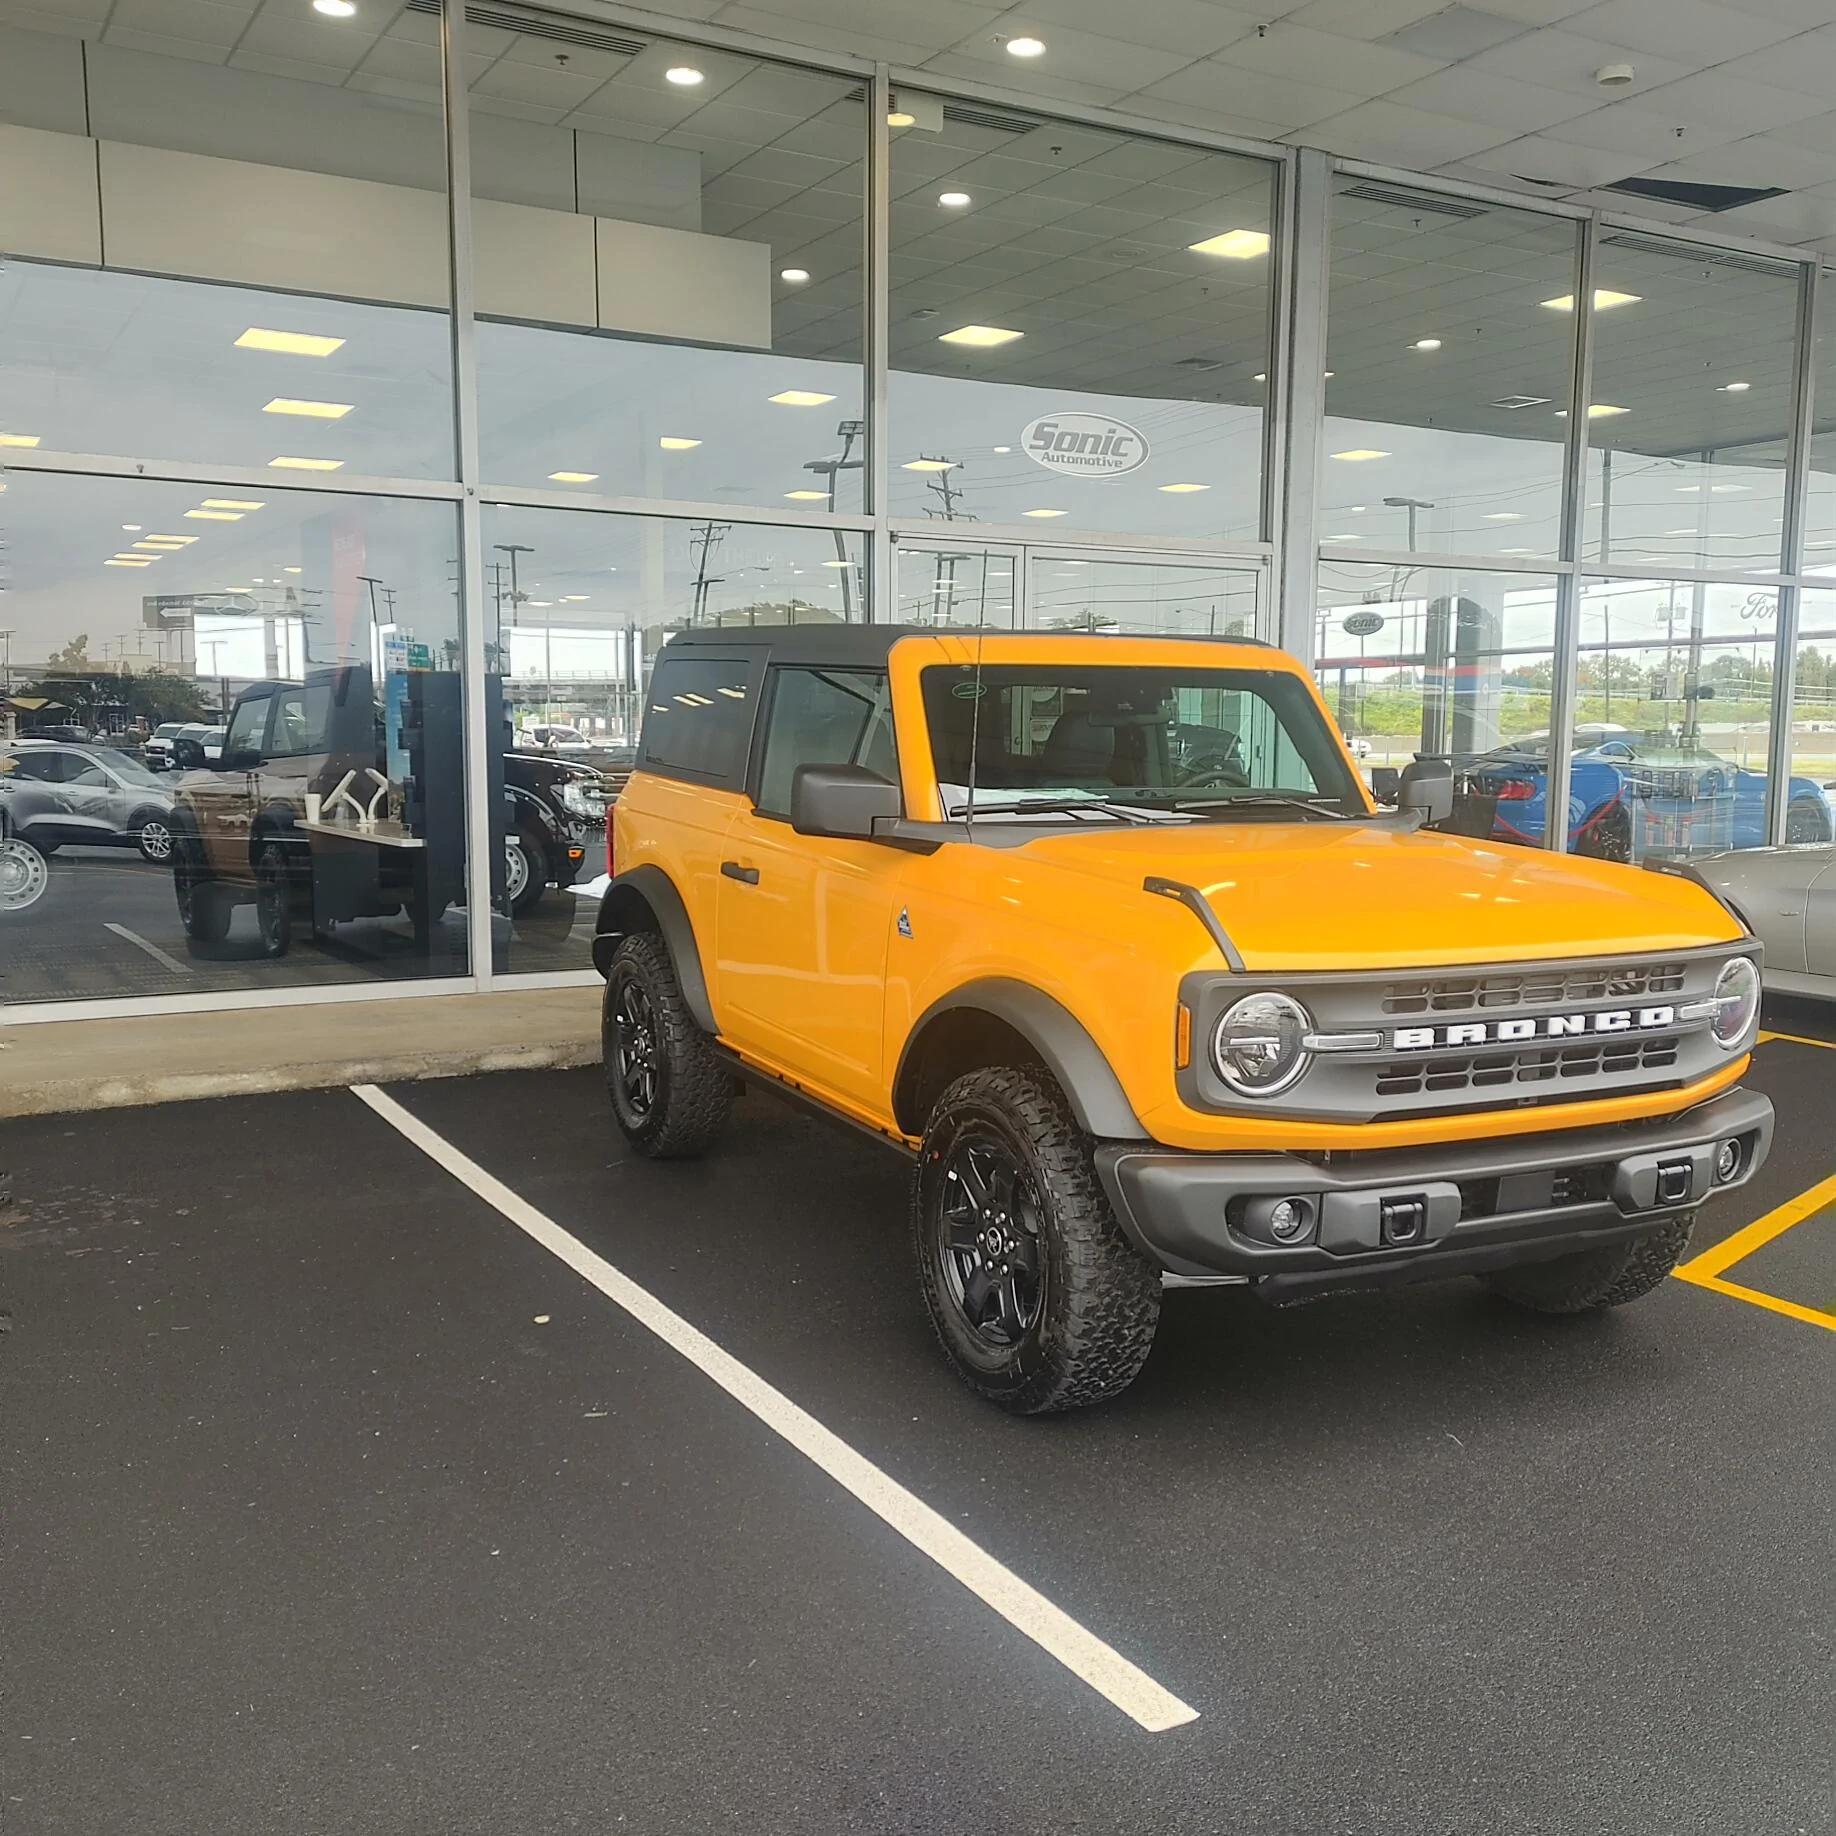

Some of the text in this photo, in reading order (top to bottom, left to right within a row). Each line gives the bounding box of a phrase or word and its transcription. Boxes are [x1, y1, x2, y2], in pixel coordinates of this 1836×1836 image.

[1028, 421, 1134, 457] Sonic
[1041, 451, 1124, 468] Automotive
[1740, 592, 1778, 620] For
[1393, 1006, 1675, 1050] BRONCO
